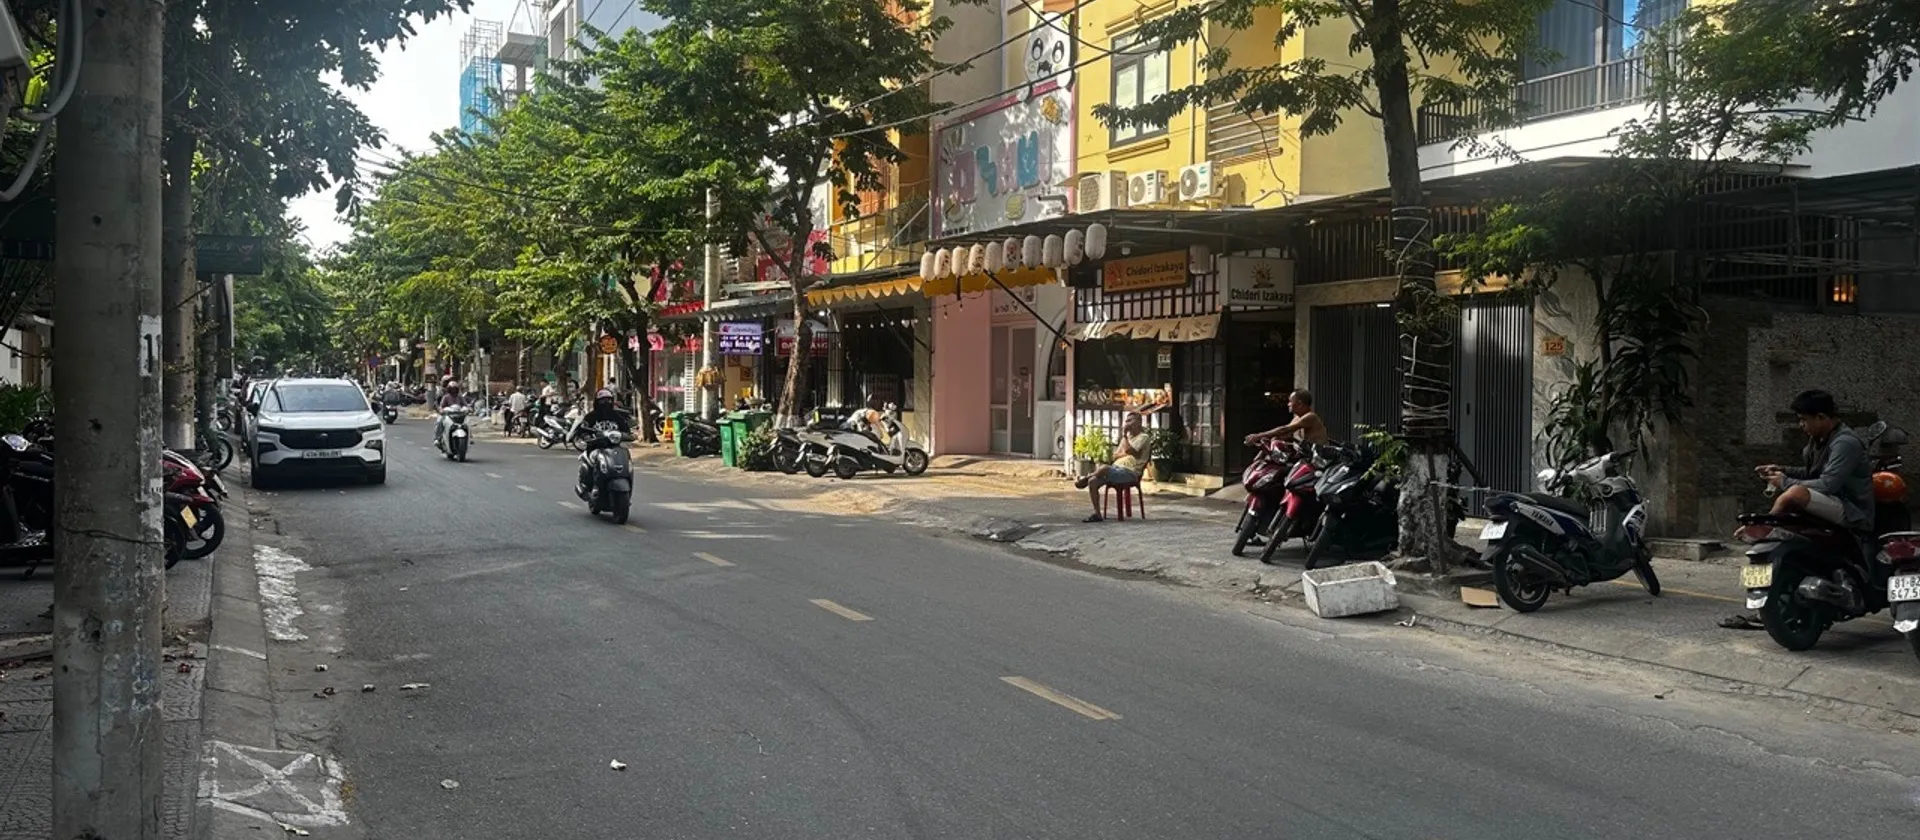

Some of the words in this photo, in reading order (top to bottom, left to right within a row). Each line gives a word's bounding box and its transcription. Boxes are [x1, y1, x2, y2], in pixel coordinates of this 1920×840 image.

[1126, 264, 1152, 276] Chidori
[1153, 261, 1184, 273] Izakaya
[1231, 288, 1260, 300] Chidori
[1262, 290, 1293, 303] Izakaya
[1545, 342, 1563, 351] 125
